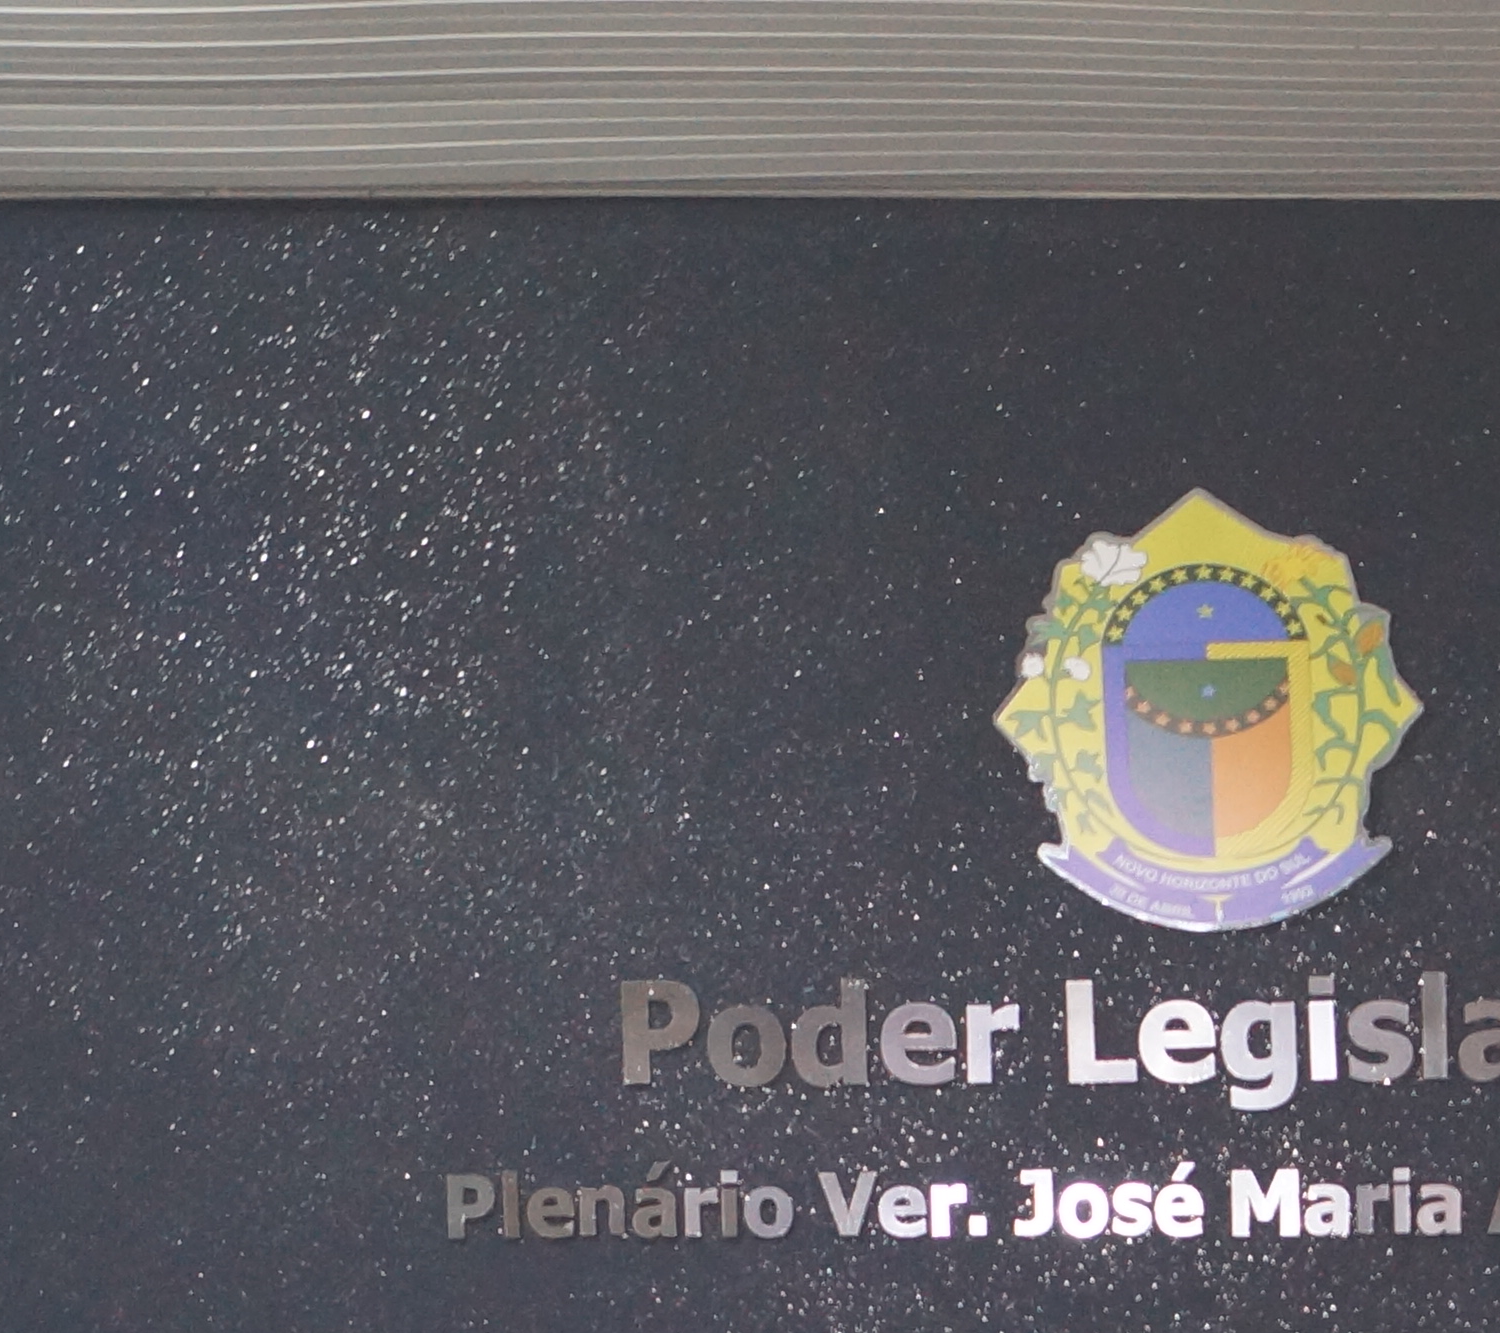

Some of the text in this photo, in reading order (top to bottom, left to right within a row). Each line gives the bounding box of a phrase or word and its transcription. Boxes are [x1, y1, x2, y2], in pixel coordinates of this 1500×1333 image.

[620, 976, 1020, 1087] Poder
[446, 1160, 794, 1239] Plenário
[818, 1171, 988, 1239] Ver.
[1012, 1161, 1205, 1239] José
[1230, 1167, 1463, 1239] Maria
